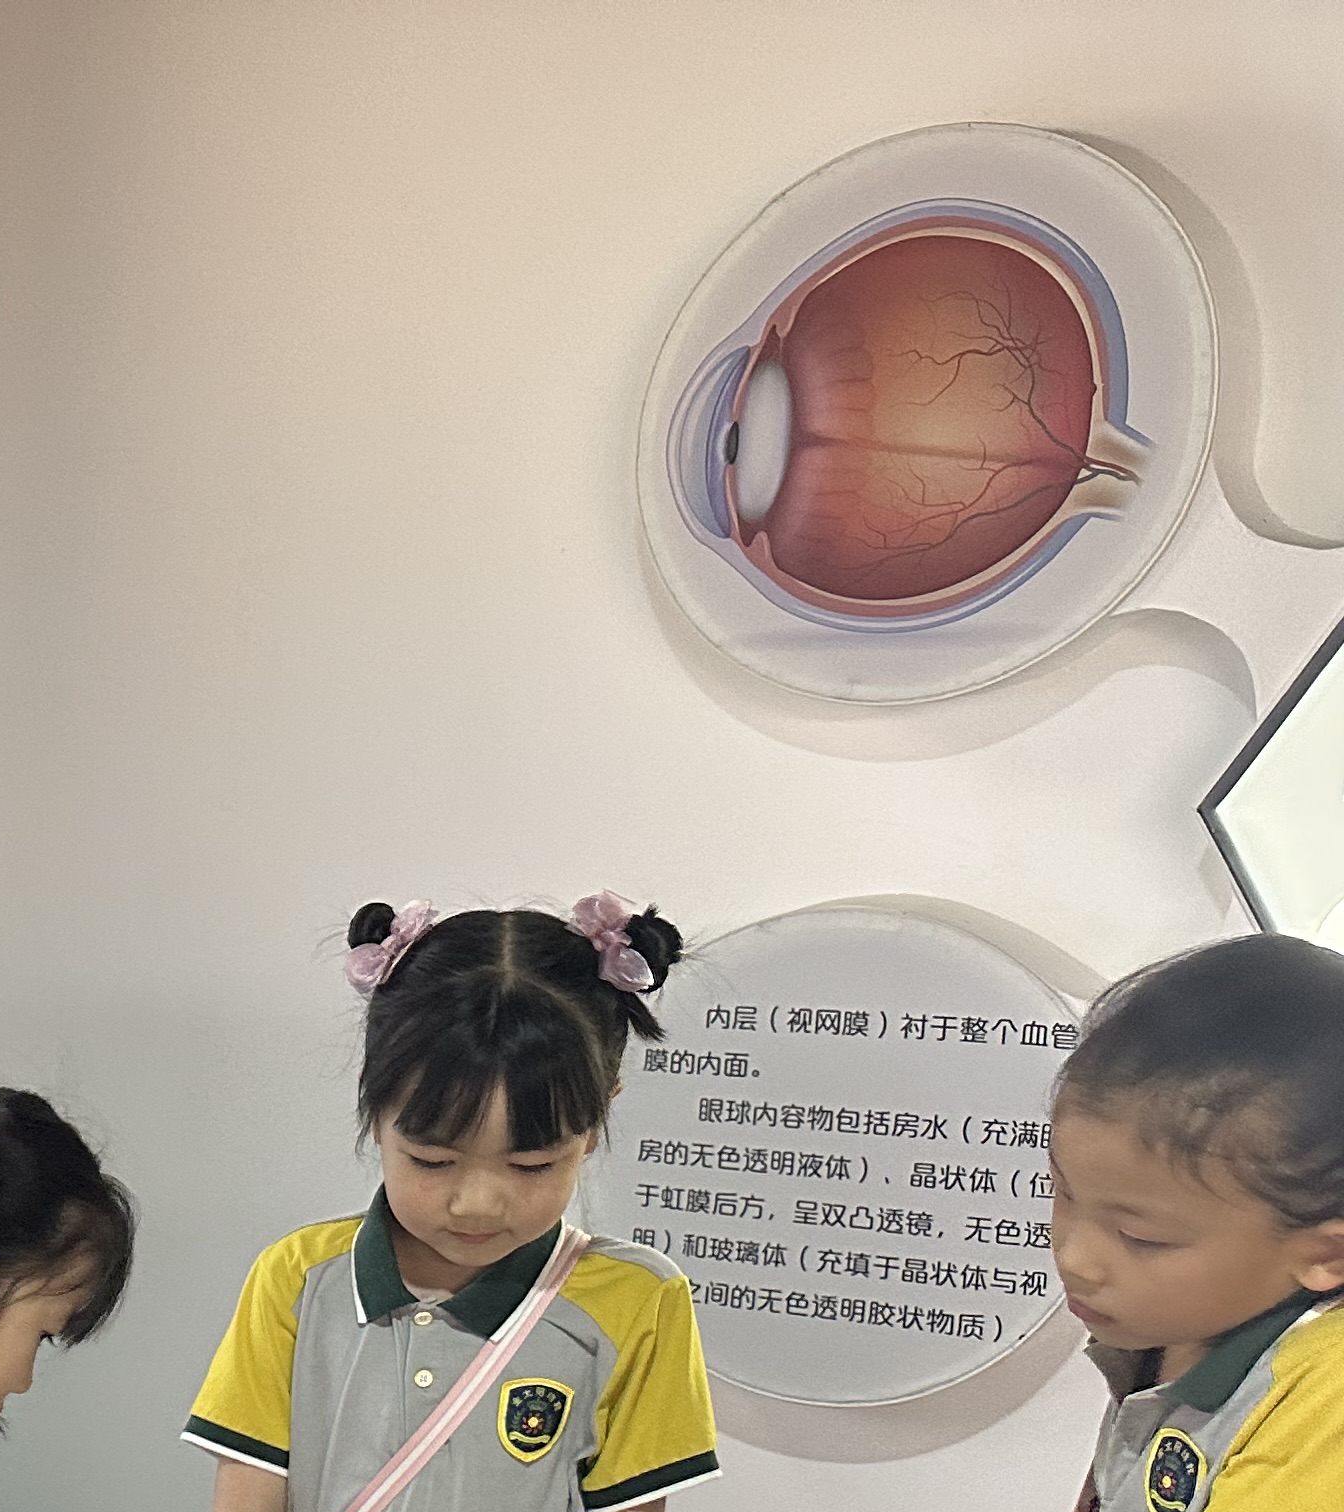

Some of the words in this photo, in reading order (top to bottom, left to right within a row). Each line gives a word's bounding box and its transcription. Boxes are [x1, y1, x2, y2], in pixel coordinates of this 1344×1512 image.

[705, 1005, 1079, 1050] 内层（视网膜）衬于整个血管
[643, 1048, 761, 1079] 膜的内面。
[637, 1140, 1056, 1199] 房的无色透明液体）、晶状体（位
[634, 1184, 1052, 1250] 于虹膜后方，呈双凸透镜，无色透
[632, 1228, 1047, 1297] 明）和玻璃体（充填于晶状体与视
